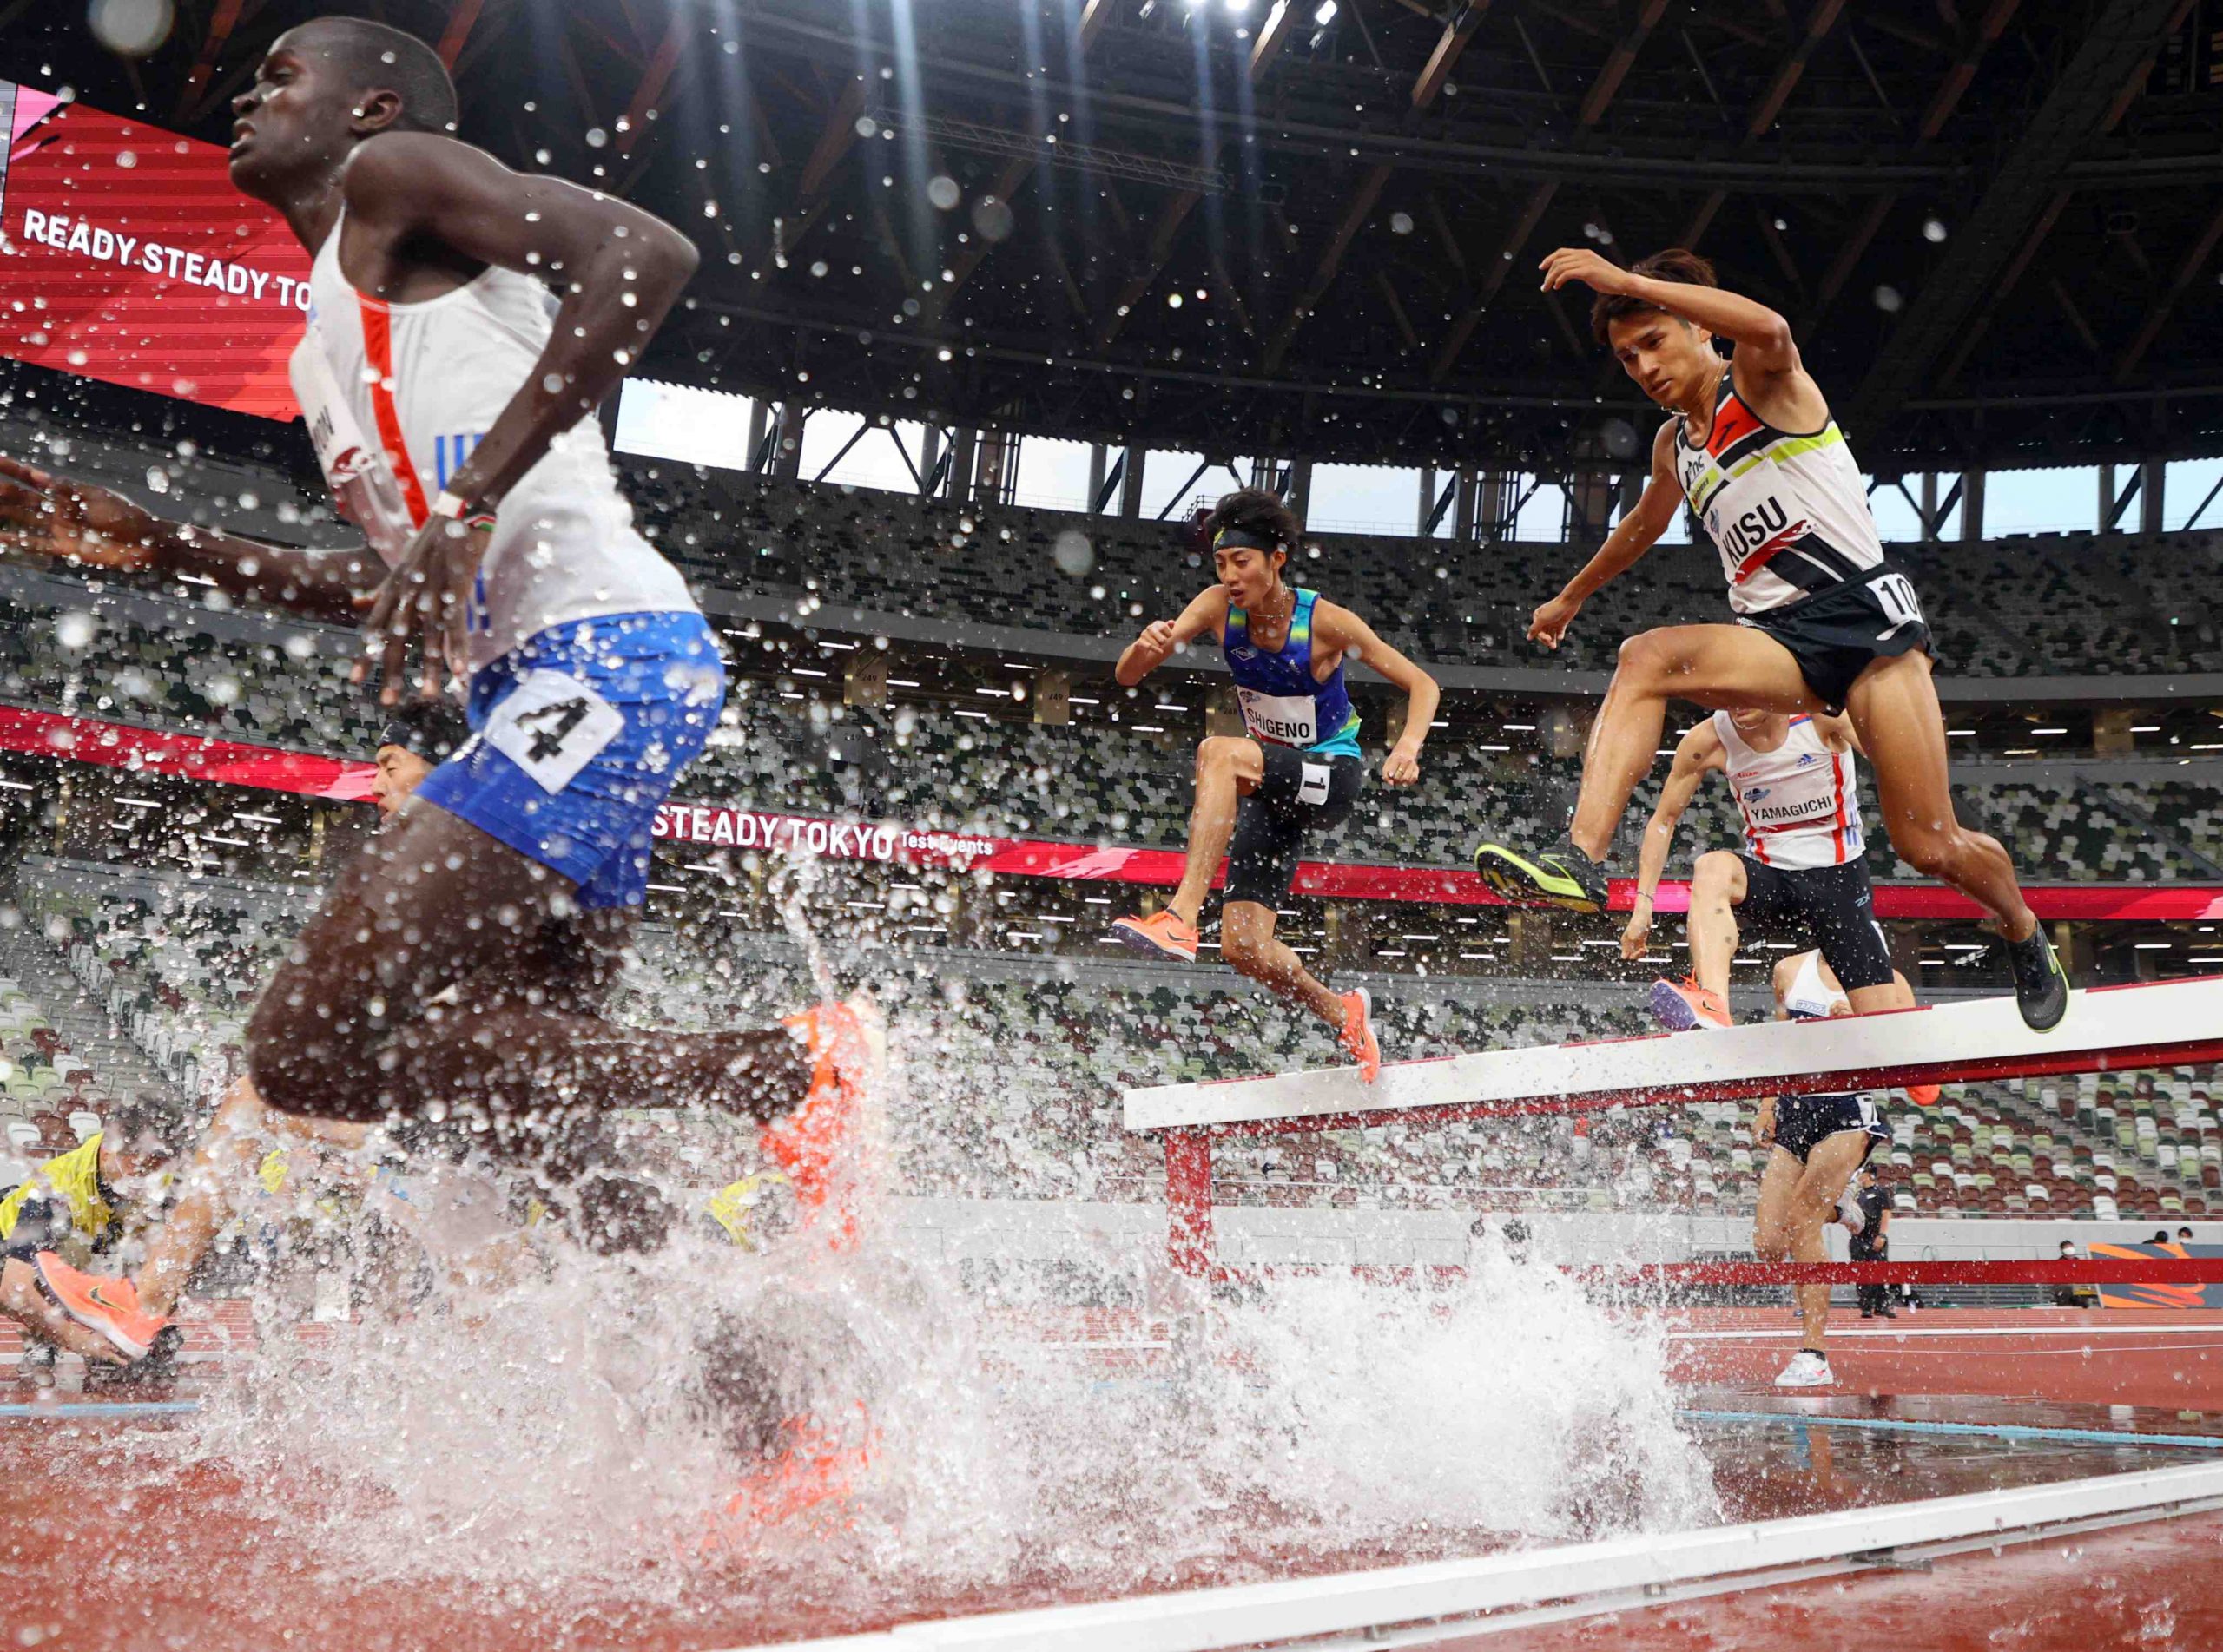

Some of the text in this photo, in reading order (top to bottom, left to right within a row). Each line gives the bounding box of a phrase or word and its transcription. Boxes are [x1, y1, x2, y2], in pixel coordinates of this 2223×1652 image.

[23, 208, 136, 266] READY
[142, 242, 269, 300] STEADY
[1722, 495, 1788, 569] KUSU
[1879, 577, 1918, 616] 10
[513, 696, 591, 764] 4
[1247, 708, 1310, 739] SHIGENO
[1303, 776, 1326, 790] 1
[1751, 795, 1833, 821] YAMAGUCHI
[651, 805, 993, 859] STEADY TOKYO Test Events
